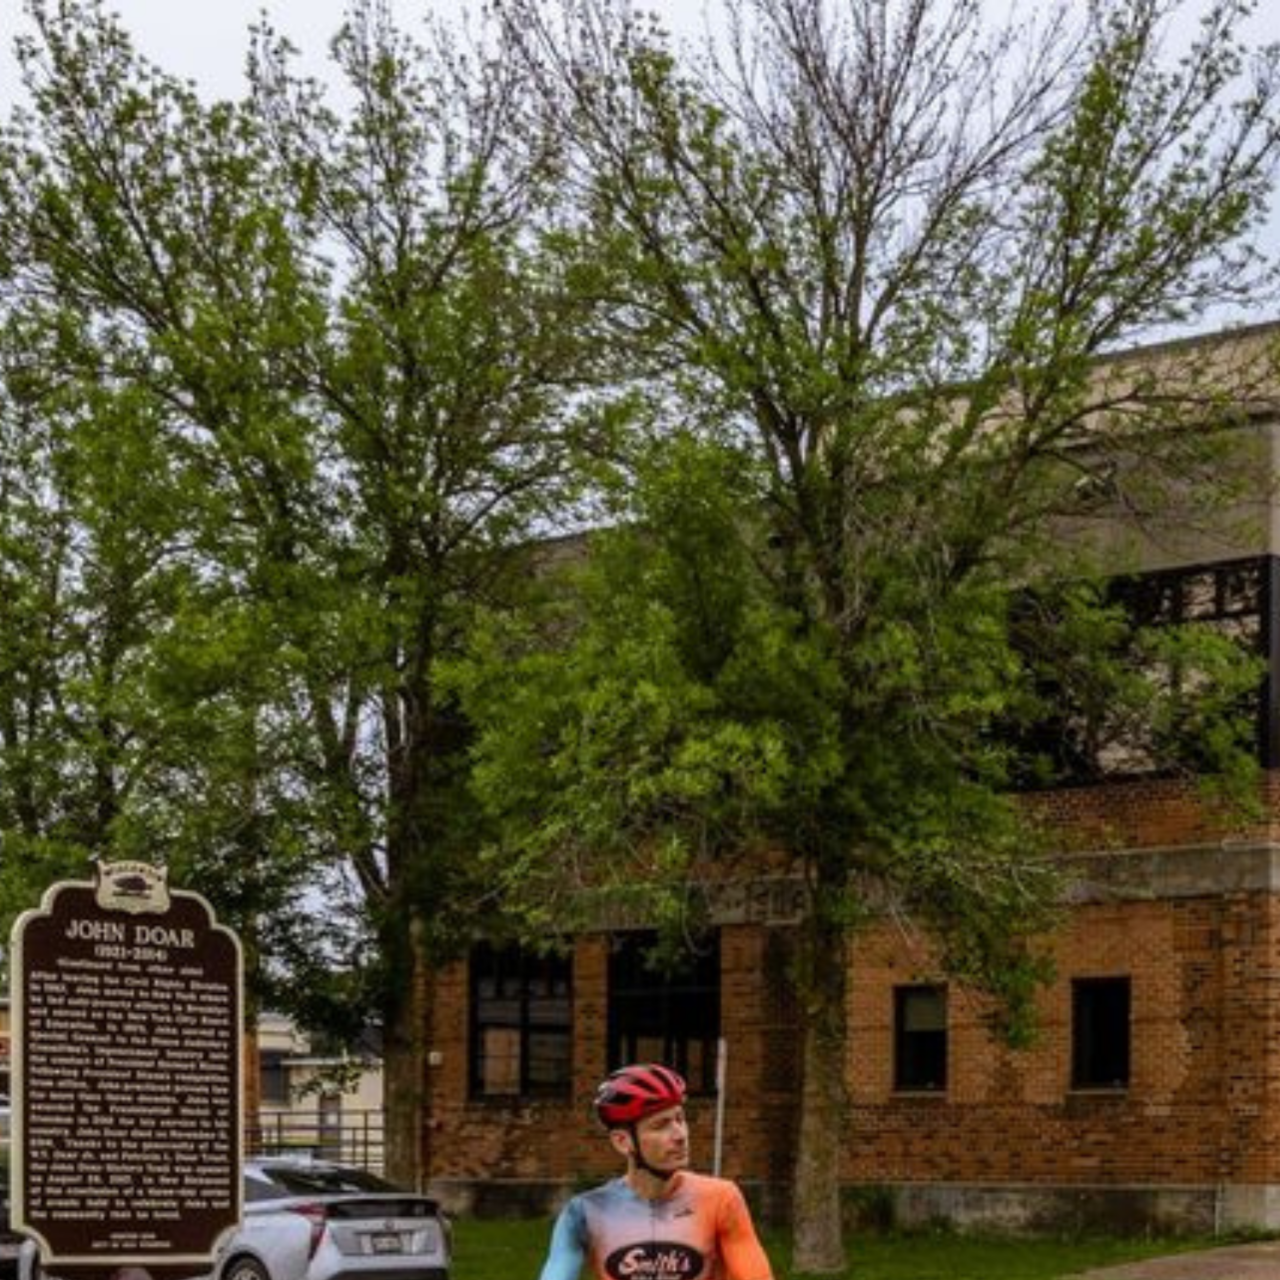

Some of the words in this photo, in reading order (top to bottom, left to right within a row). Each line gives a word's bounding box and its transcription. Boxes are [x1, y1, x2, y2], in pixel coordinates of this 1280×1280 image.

[65, 919, 125, 942] JOHN
[134, 925, 195, 949] DOAR
[618, 1248, 692, 1275] Smith's
